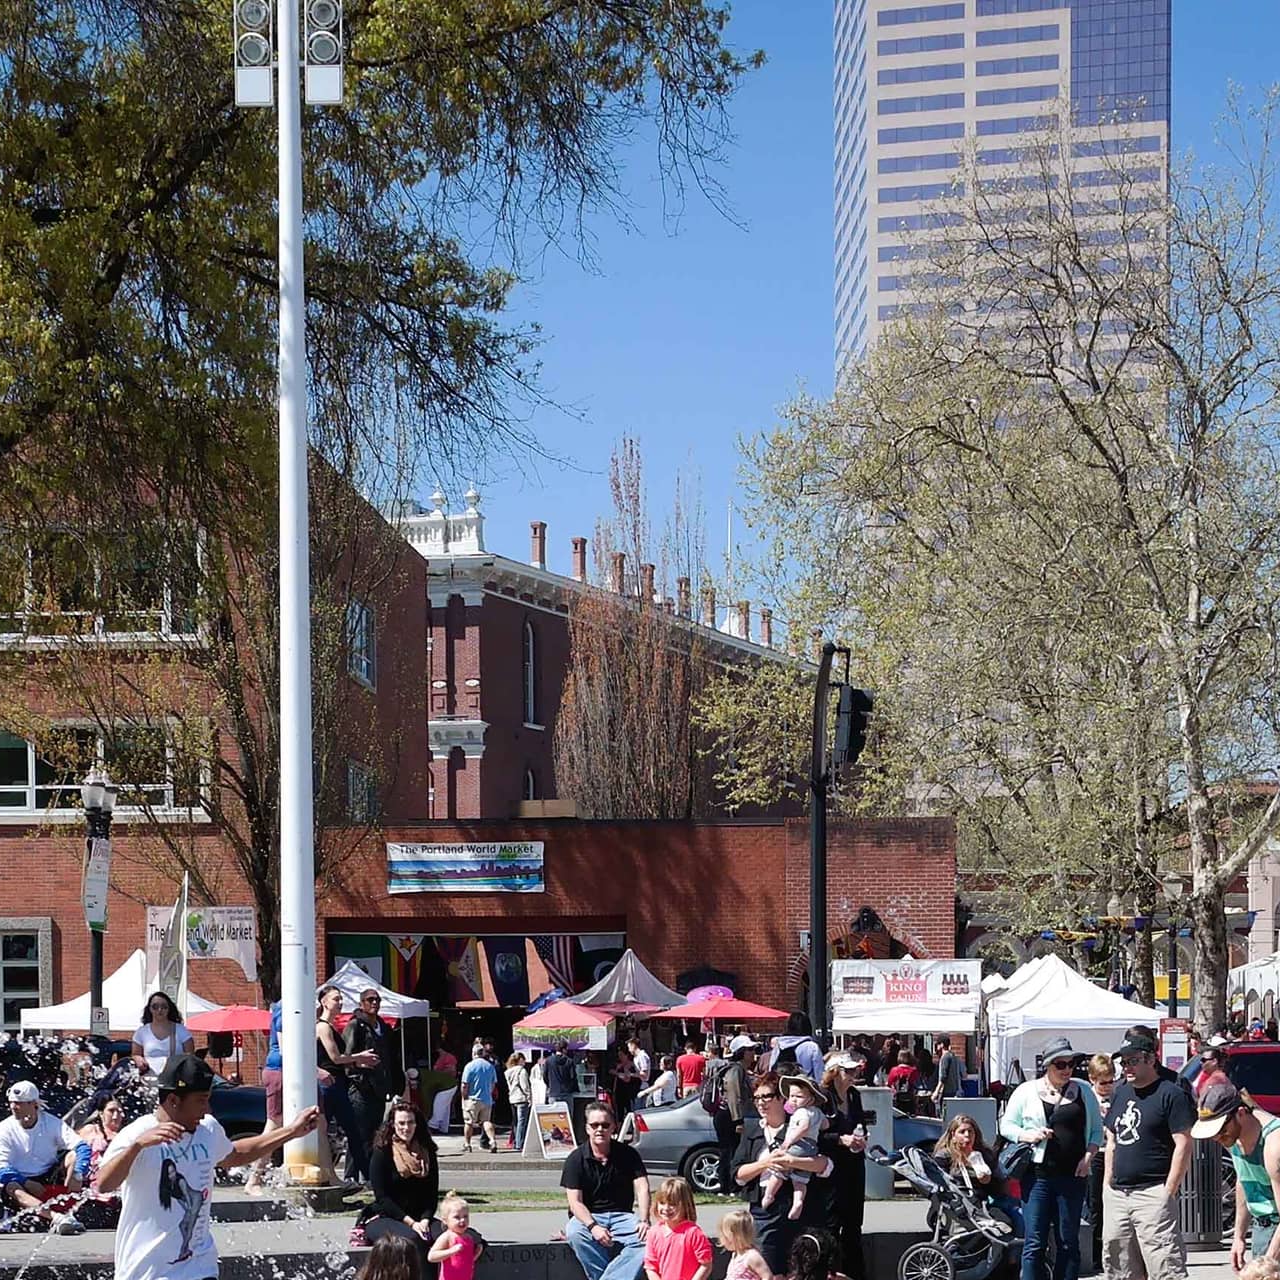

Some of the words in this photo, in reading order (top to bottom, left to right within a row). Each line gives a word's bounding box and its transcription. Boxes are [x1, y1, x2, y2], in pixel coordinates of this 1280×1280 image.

[399, 844, 418, 855] The
[421, 844, 464, 855] Portland
[466, 844, 496, 855] World
[499, 844, 534, 855] Market
[149, 924, 166, 941] The
[227, 923, 253, 941] Market
[889, 982, 922, 992] KING
[889, 993, 922, 1001] CAJUN
